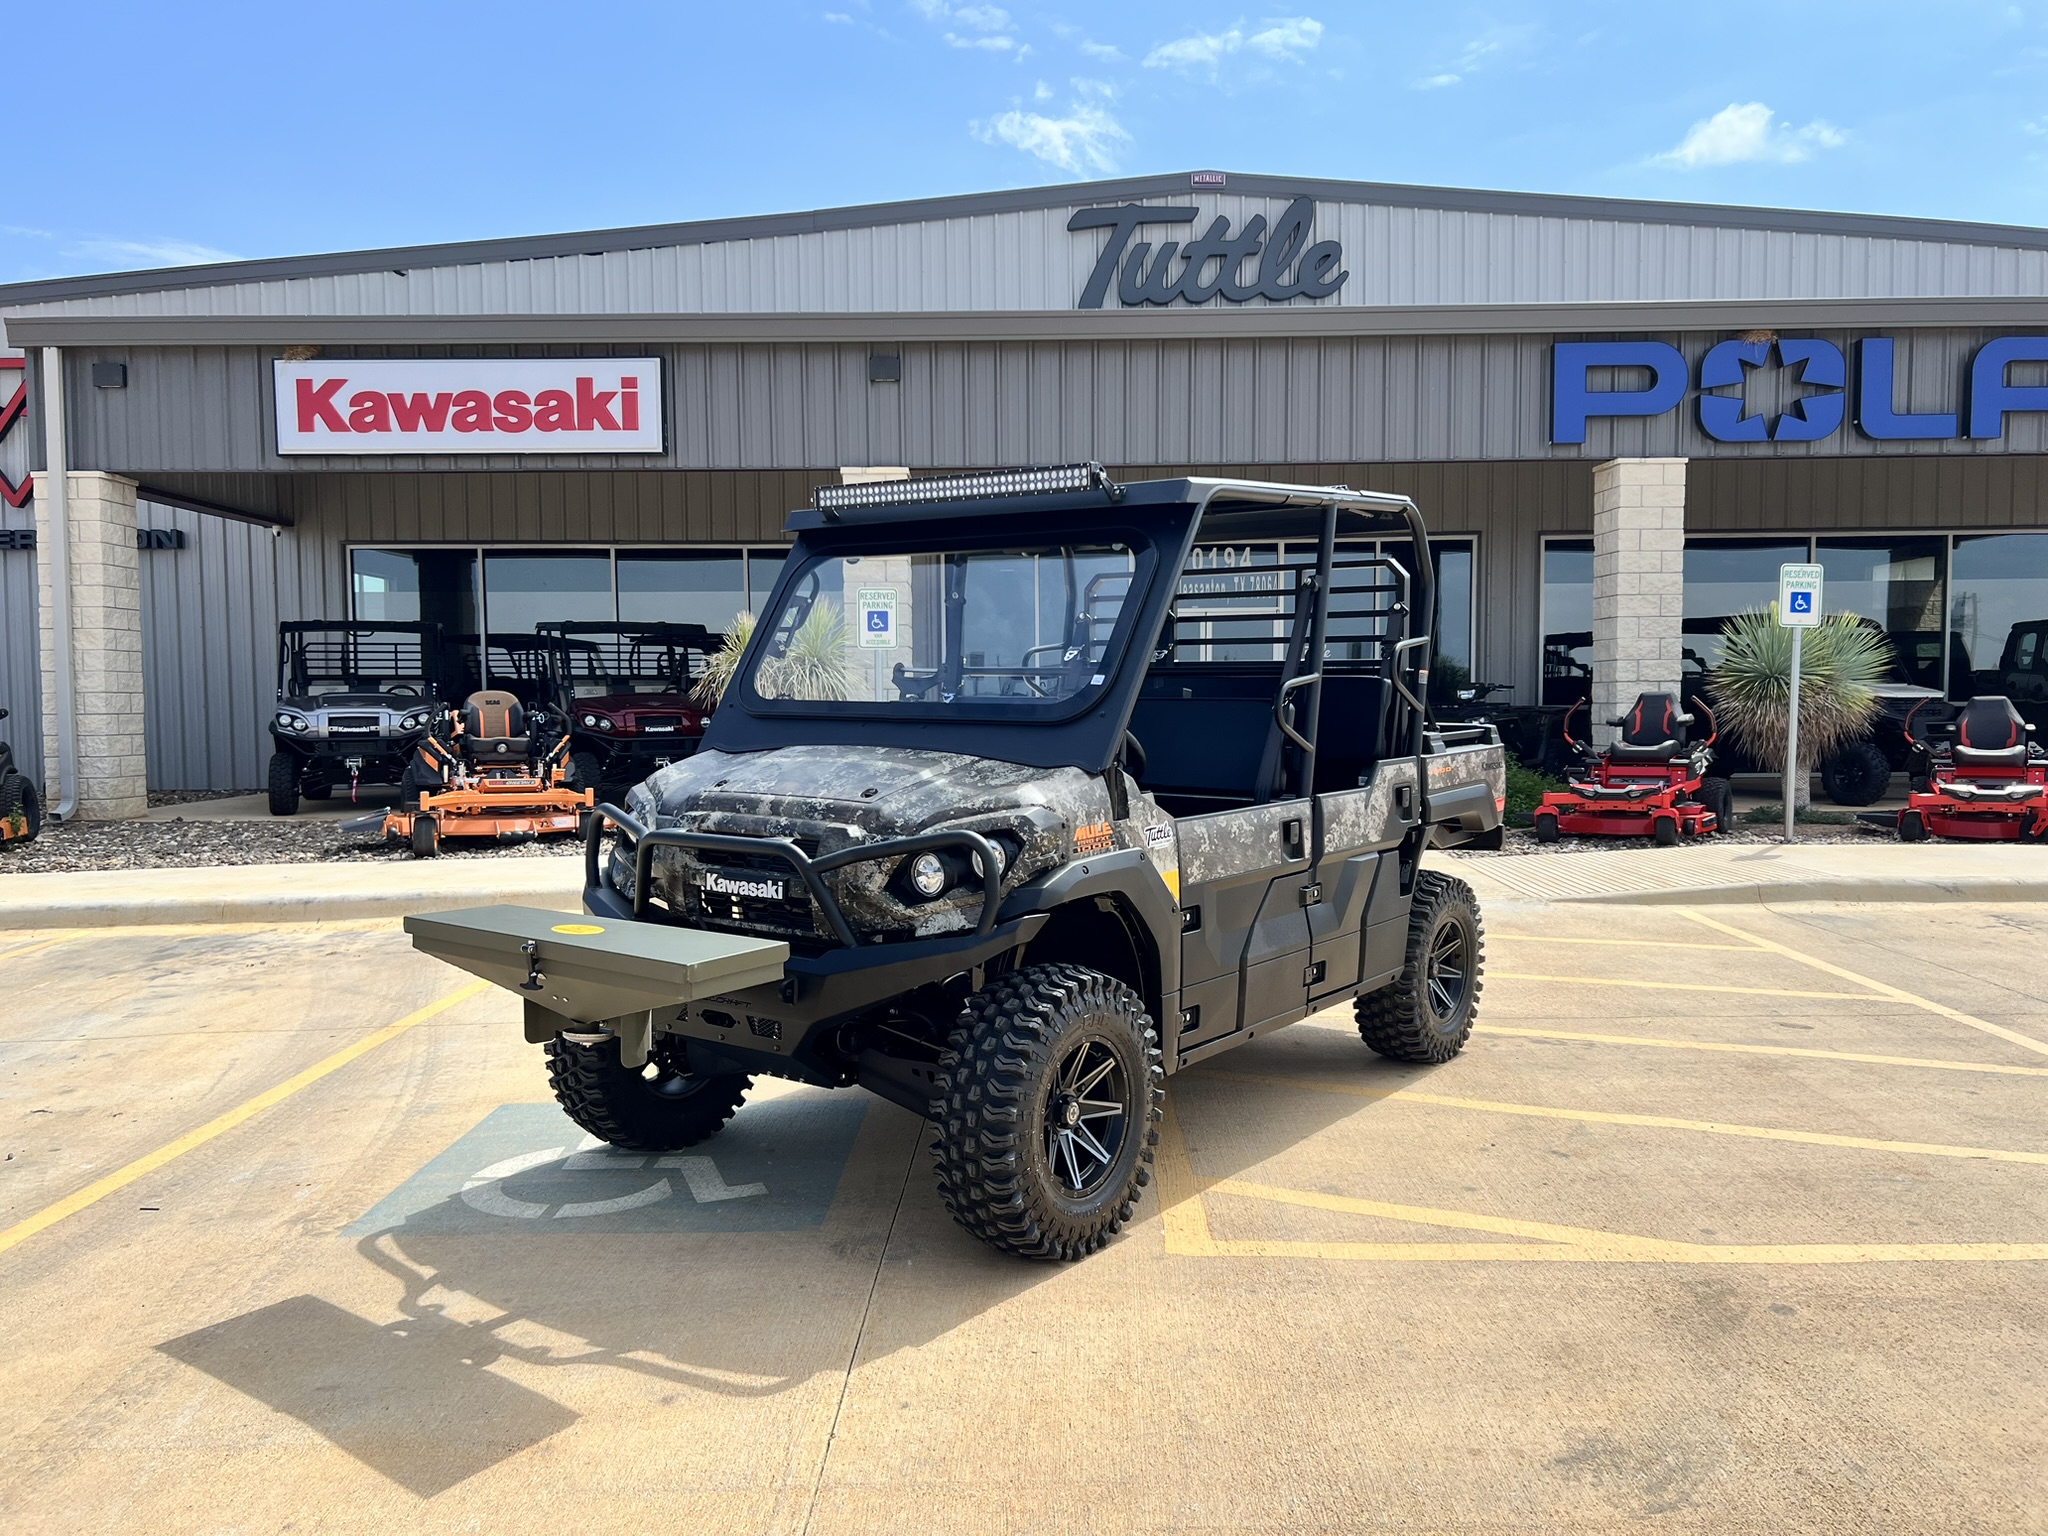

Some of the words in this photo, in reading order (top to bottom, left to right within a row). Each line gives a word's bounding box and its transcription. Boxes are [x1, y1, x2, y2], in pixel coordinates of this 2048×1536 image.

[1194, 174, 1223, 183] METALLIC
[1067, 196, 1349, 309] Tuttle
[295, 376, 639, 433] Kawasaki
[1784, 569, 1820, 579] RESERVED
[1786, 580, 1817, 590] PARKING
[860, 591, 896, 601] RESERVED
[862, 601, 893, 610] PARKING
[645, 725, 674, 733] Kawasaki
[1073, 821, 1114, 842] MULE
[1144, 821, 1173, 847] Tuttle
[1078, 841, 1113, 853] 1000
[705, 872, 784, 900] Kawasaki
